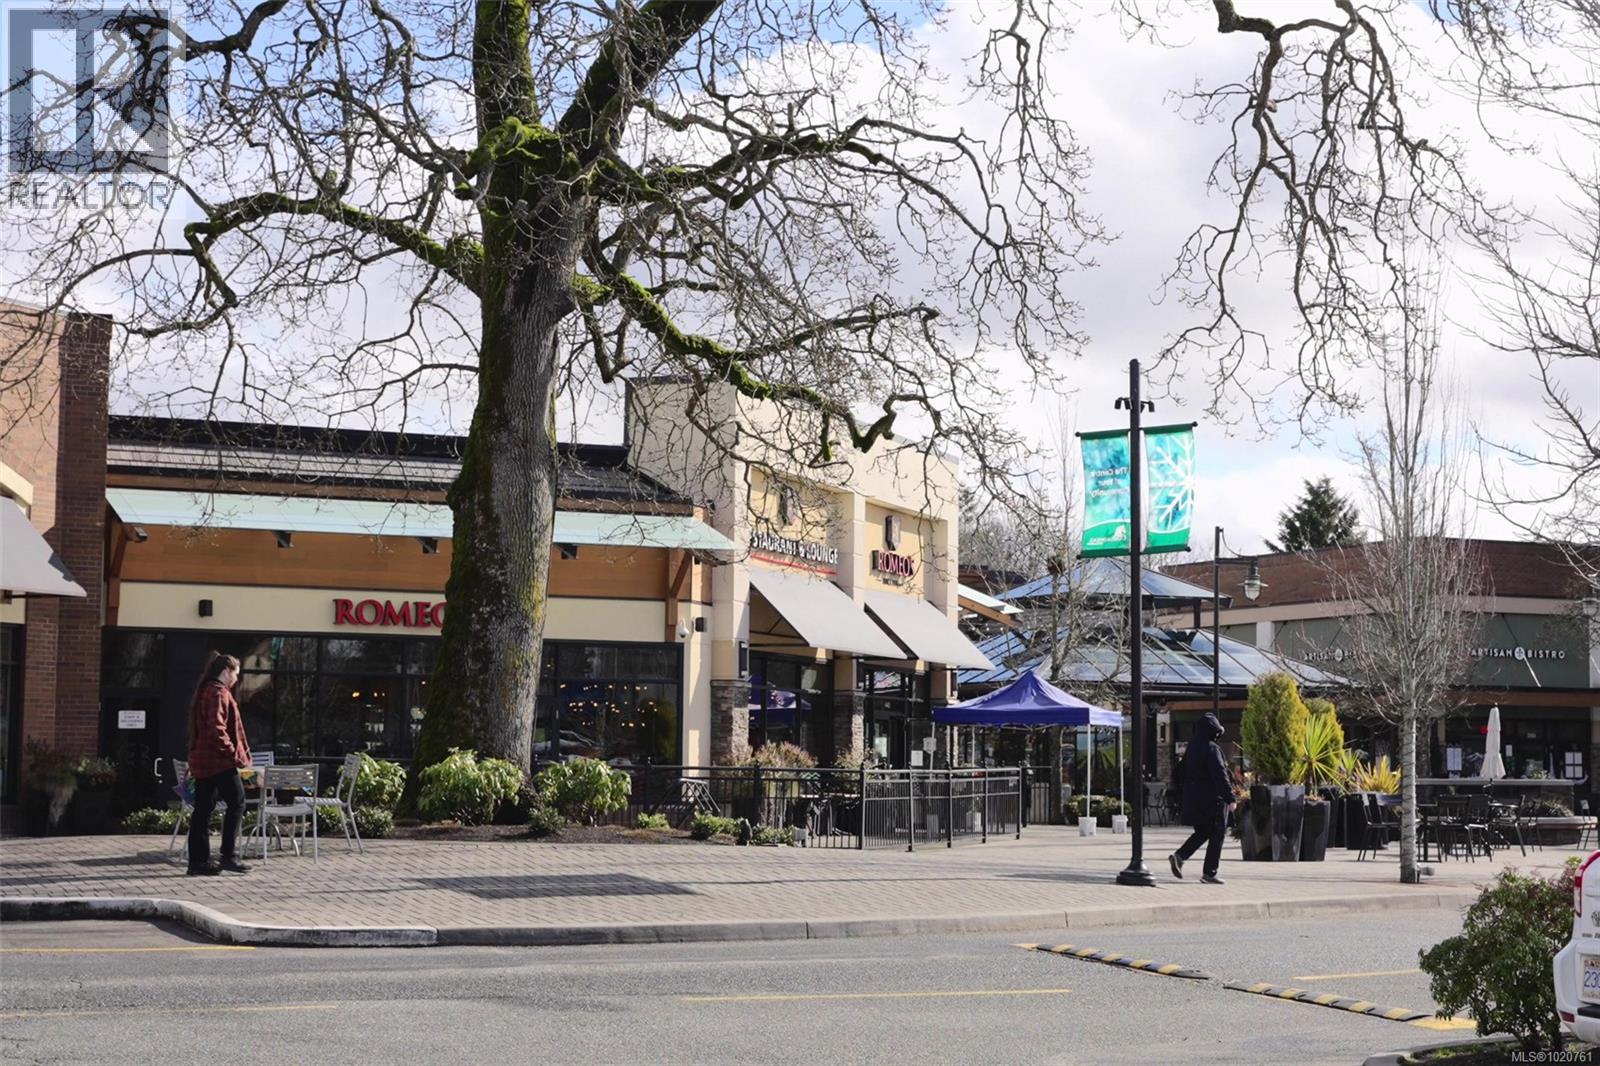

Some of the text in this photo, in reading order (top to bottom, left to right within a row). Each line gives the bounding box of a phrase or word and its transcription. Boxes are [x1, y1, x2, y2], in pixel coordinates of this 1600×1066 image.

[806, 541, 838, 565] LOUNGE
[1470, 647, 1566, 659] ARTISAN BISTRO
